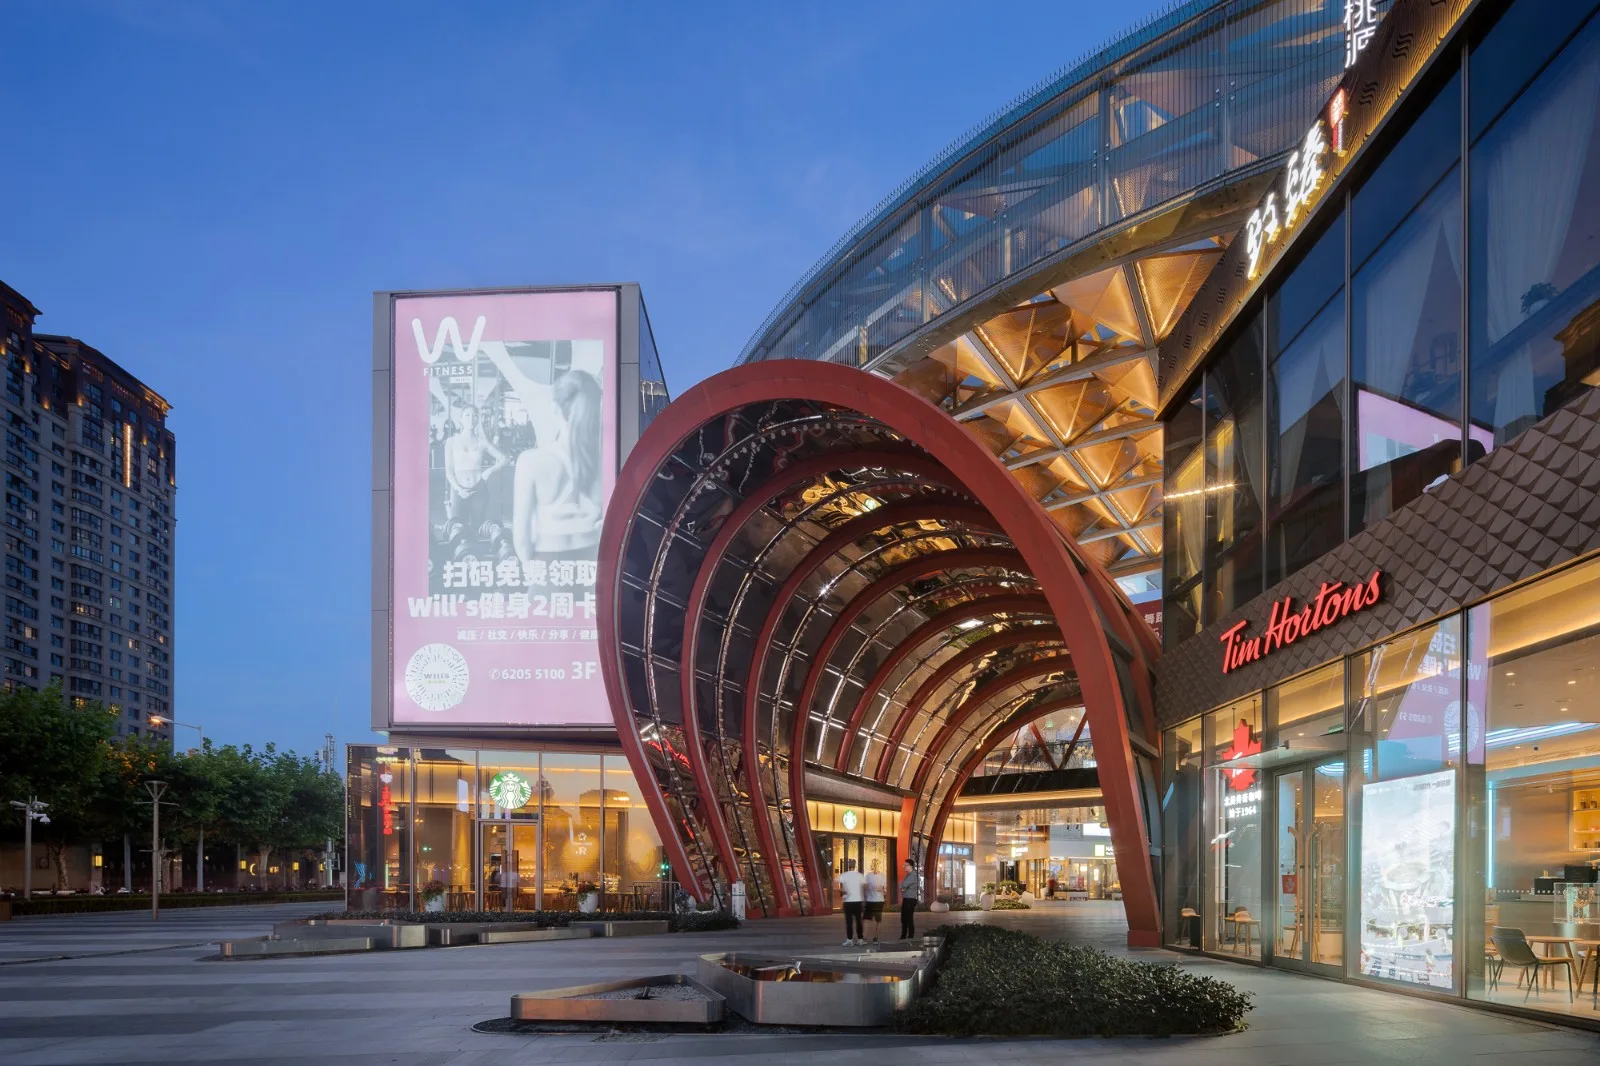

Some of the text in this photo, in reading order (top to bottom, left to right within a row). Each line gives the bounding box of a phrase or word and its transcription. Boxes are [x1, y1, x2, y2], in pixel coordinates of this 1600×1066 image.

[423, 365, 473, 377] FITNESS
[443, 559, 597, 588] 扫码免费领取
[1220, 620, 1261, 674] Tim
[1264, 570, 1380, 655] Hortons
[487, 629, 508, 640] 社交
[517, 629, 538, 640] 快乐
[549, 629, 569, 640] 分享
[501, 661, 597, 680] 6205 5100 3F
